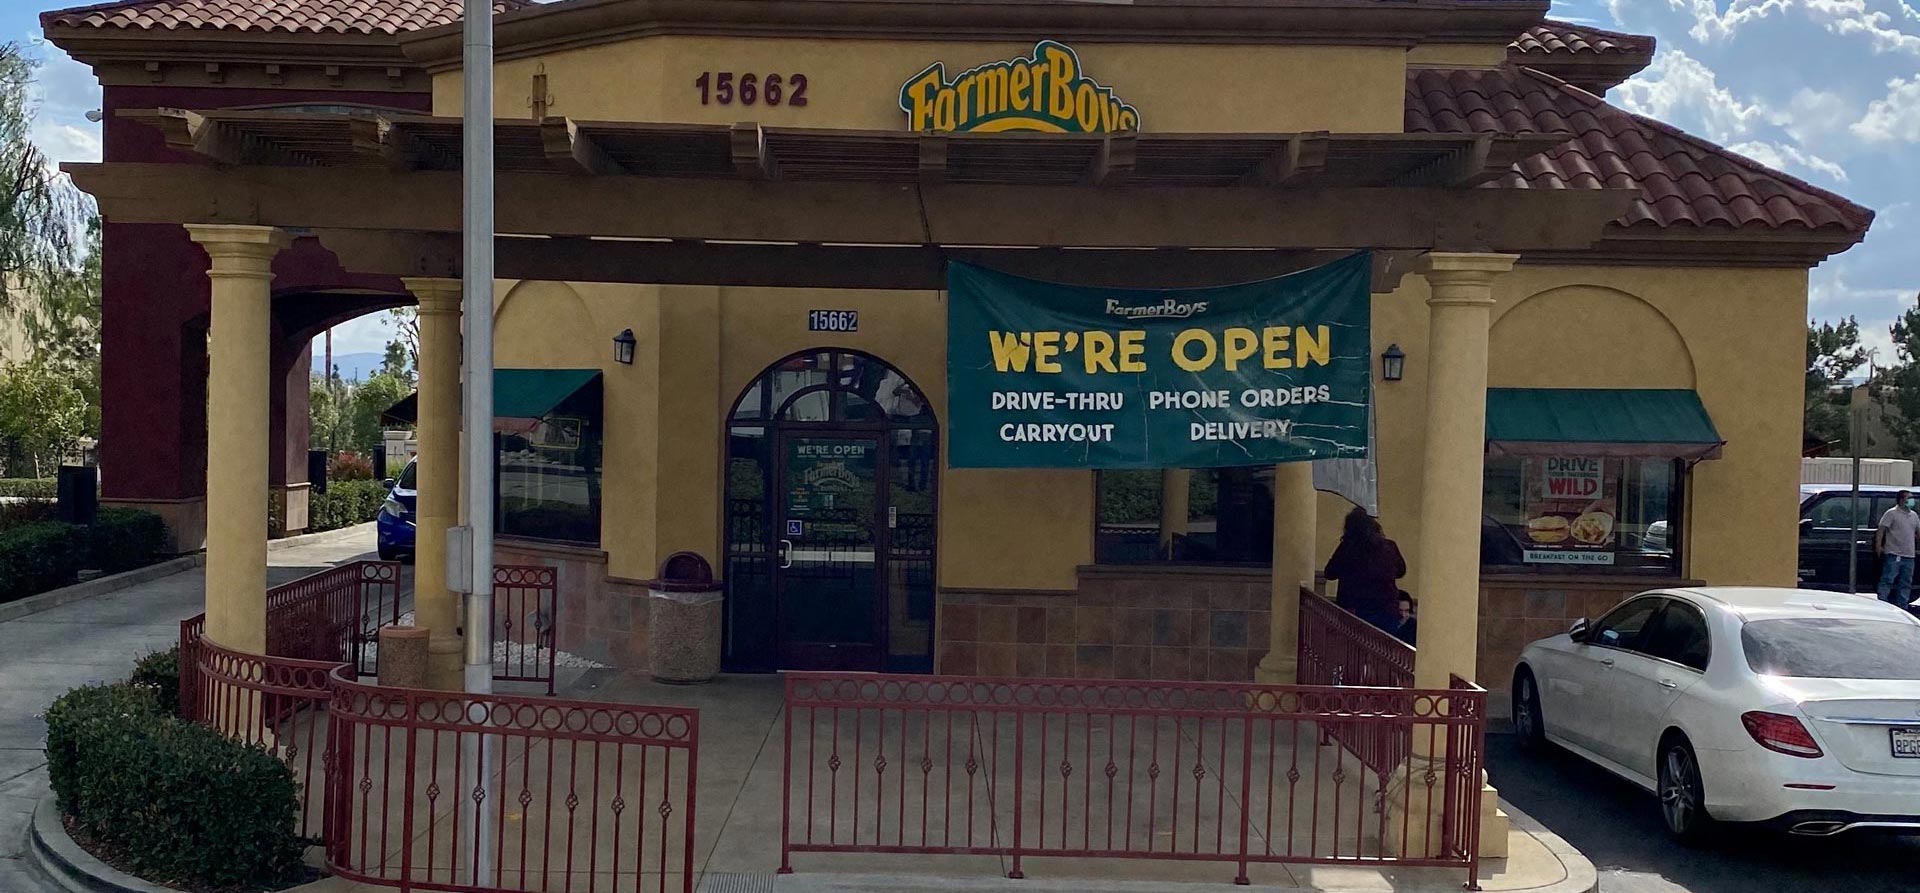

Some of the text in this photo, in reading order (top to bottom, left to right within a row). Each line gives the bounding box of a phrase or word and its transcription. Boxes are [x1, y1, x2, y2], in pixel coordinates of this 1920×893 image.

[695, 71, 809, 107] 15662
[810, 310, 858, 330] 15662
[988, 325, 1331, 373] WE'RE OPEN
[992, 391, 1124, 411] DRIVE-THRU
[1149, 384, 1331, 410] PHONE ORDERS
[999, 423, 1115, 442] CARRYOUT
[1190, 418, 1292, 442] DELIVERY
[797, 445, 865, 455] WE'RE OPEN
[1548, 457, 1598, 471] DRIVE
[1548, 478, 1598, 496] WILD
